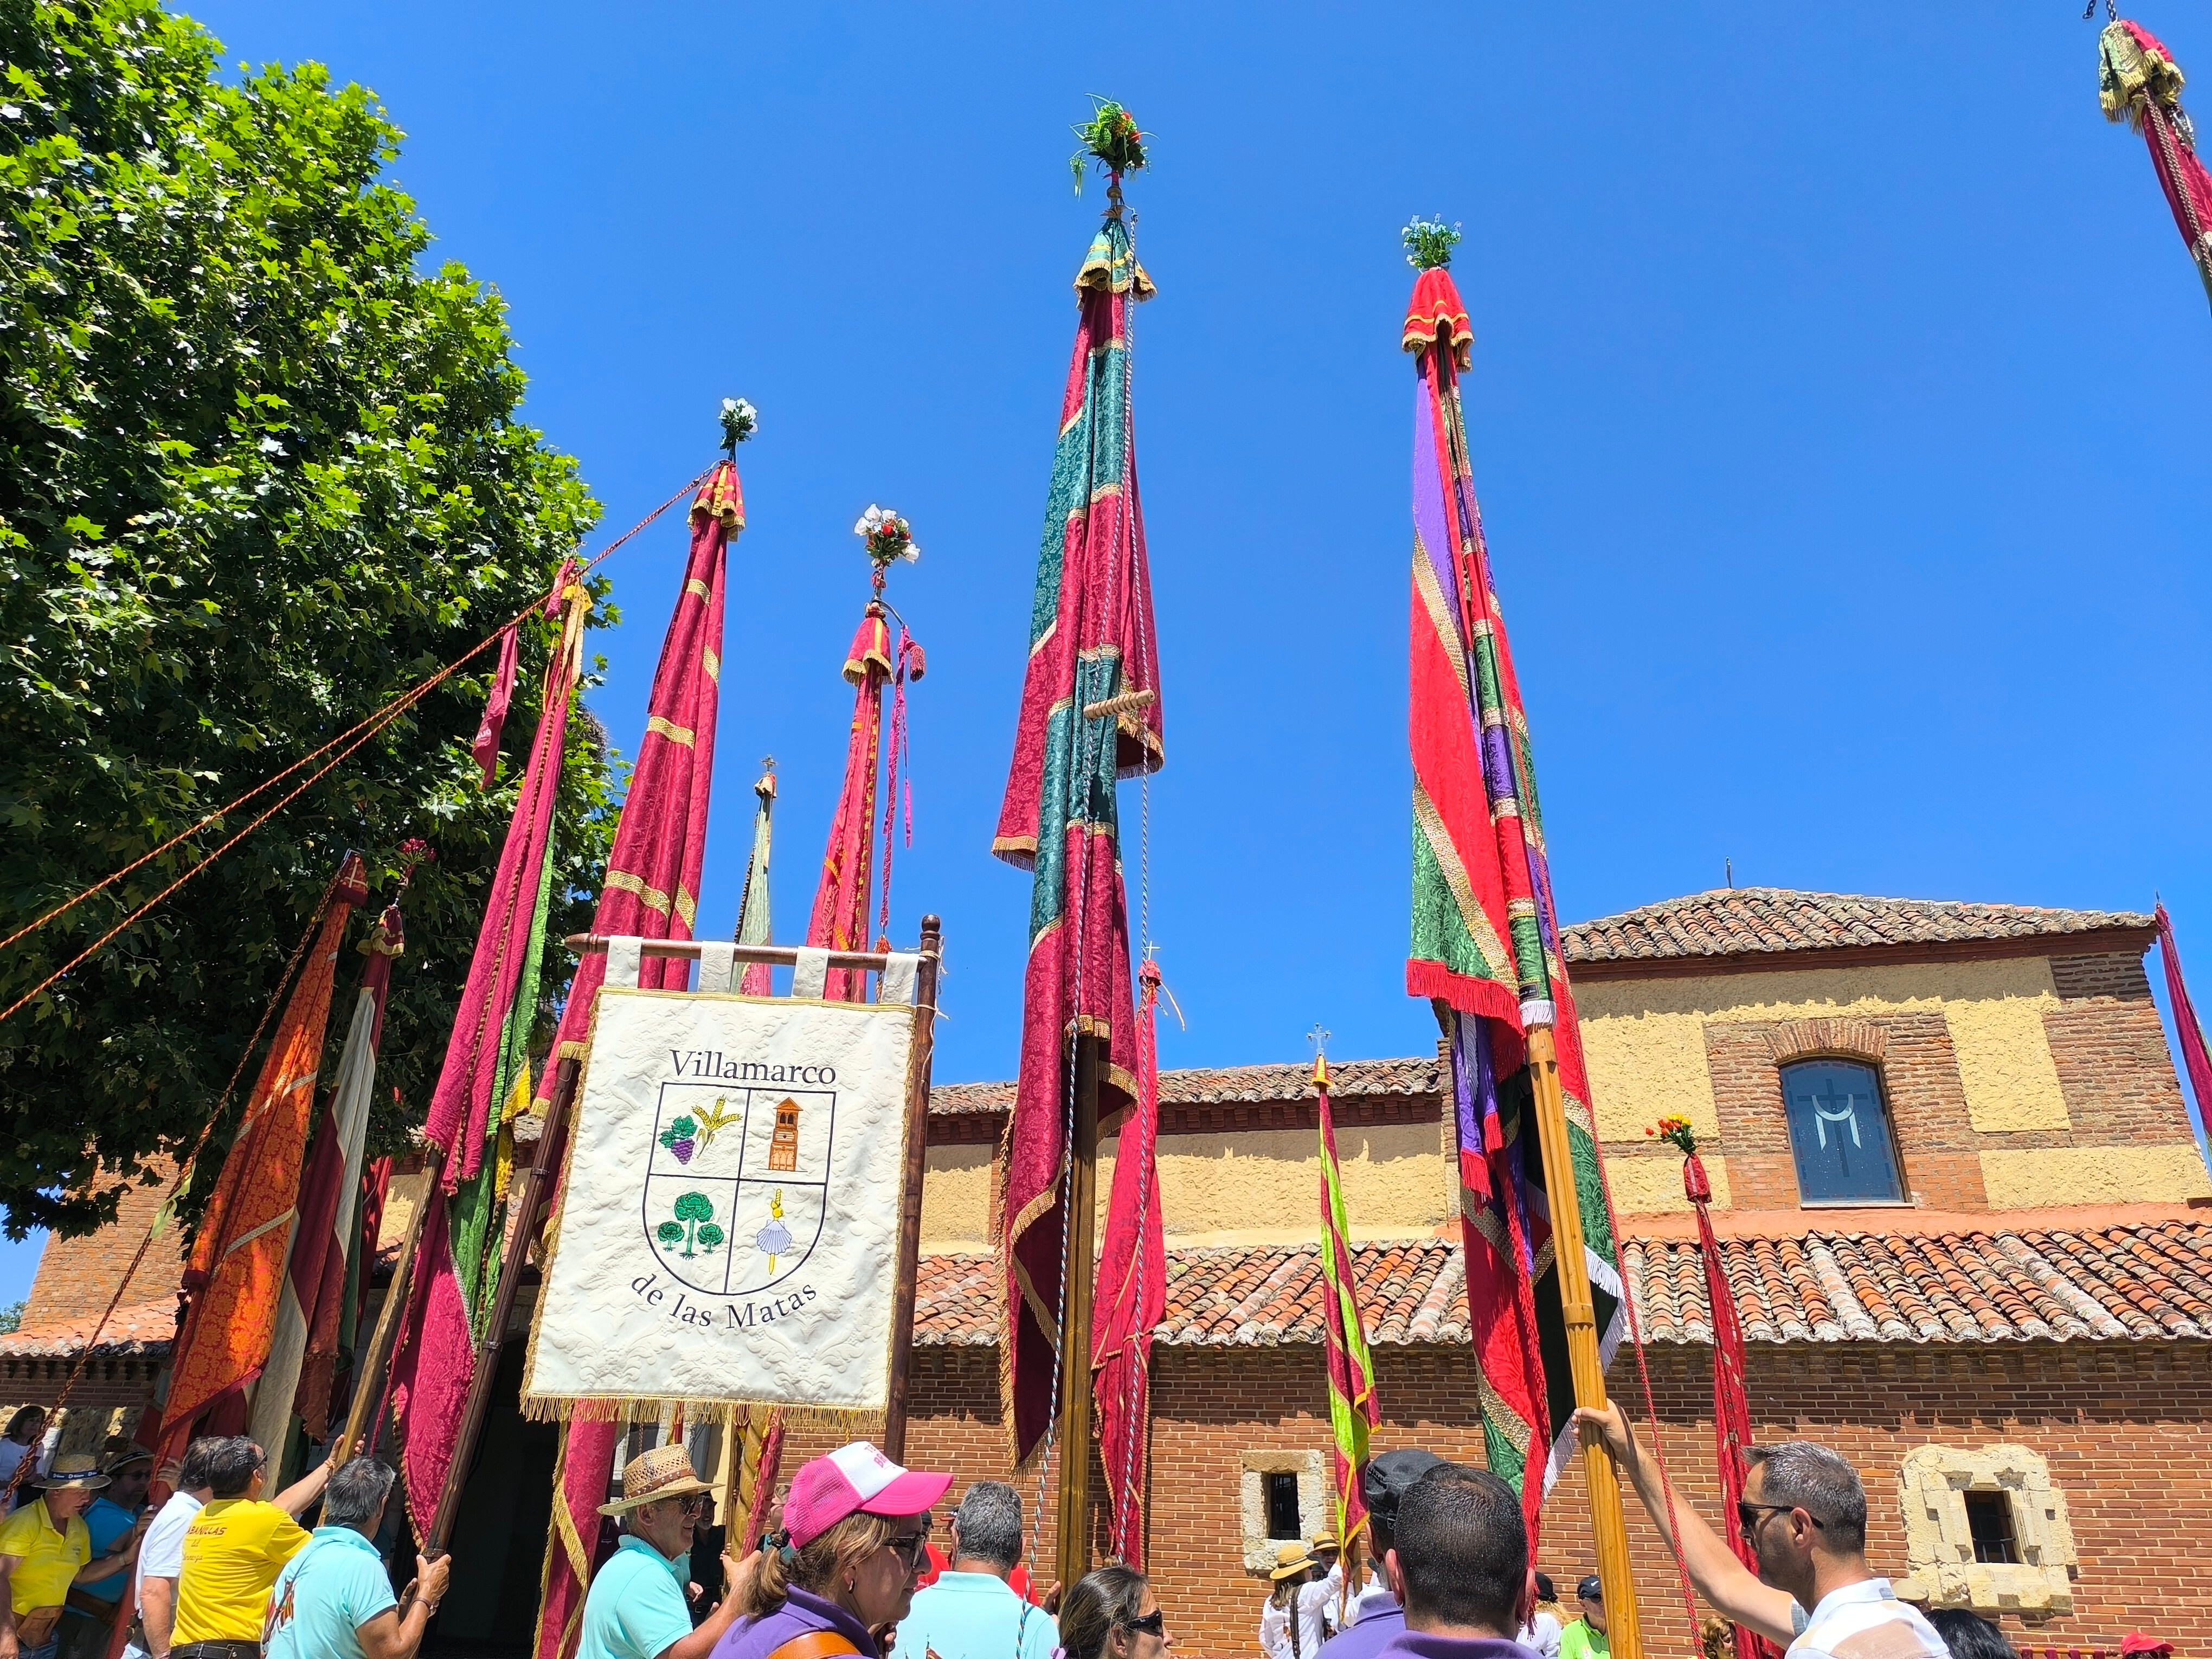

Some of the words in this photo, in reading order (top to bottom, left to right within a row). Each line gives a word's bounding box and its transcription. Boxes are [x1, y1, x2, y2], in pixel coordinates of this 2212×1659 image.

[668, 1049, 836, 1084] Villamarco
[631, 1273, 664, 1306] de
[668, 1293, 712, 1327] las
[725, 1284, 817, 1329] Matas
